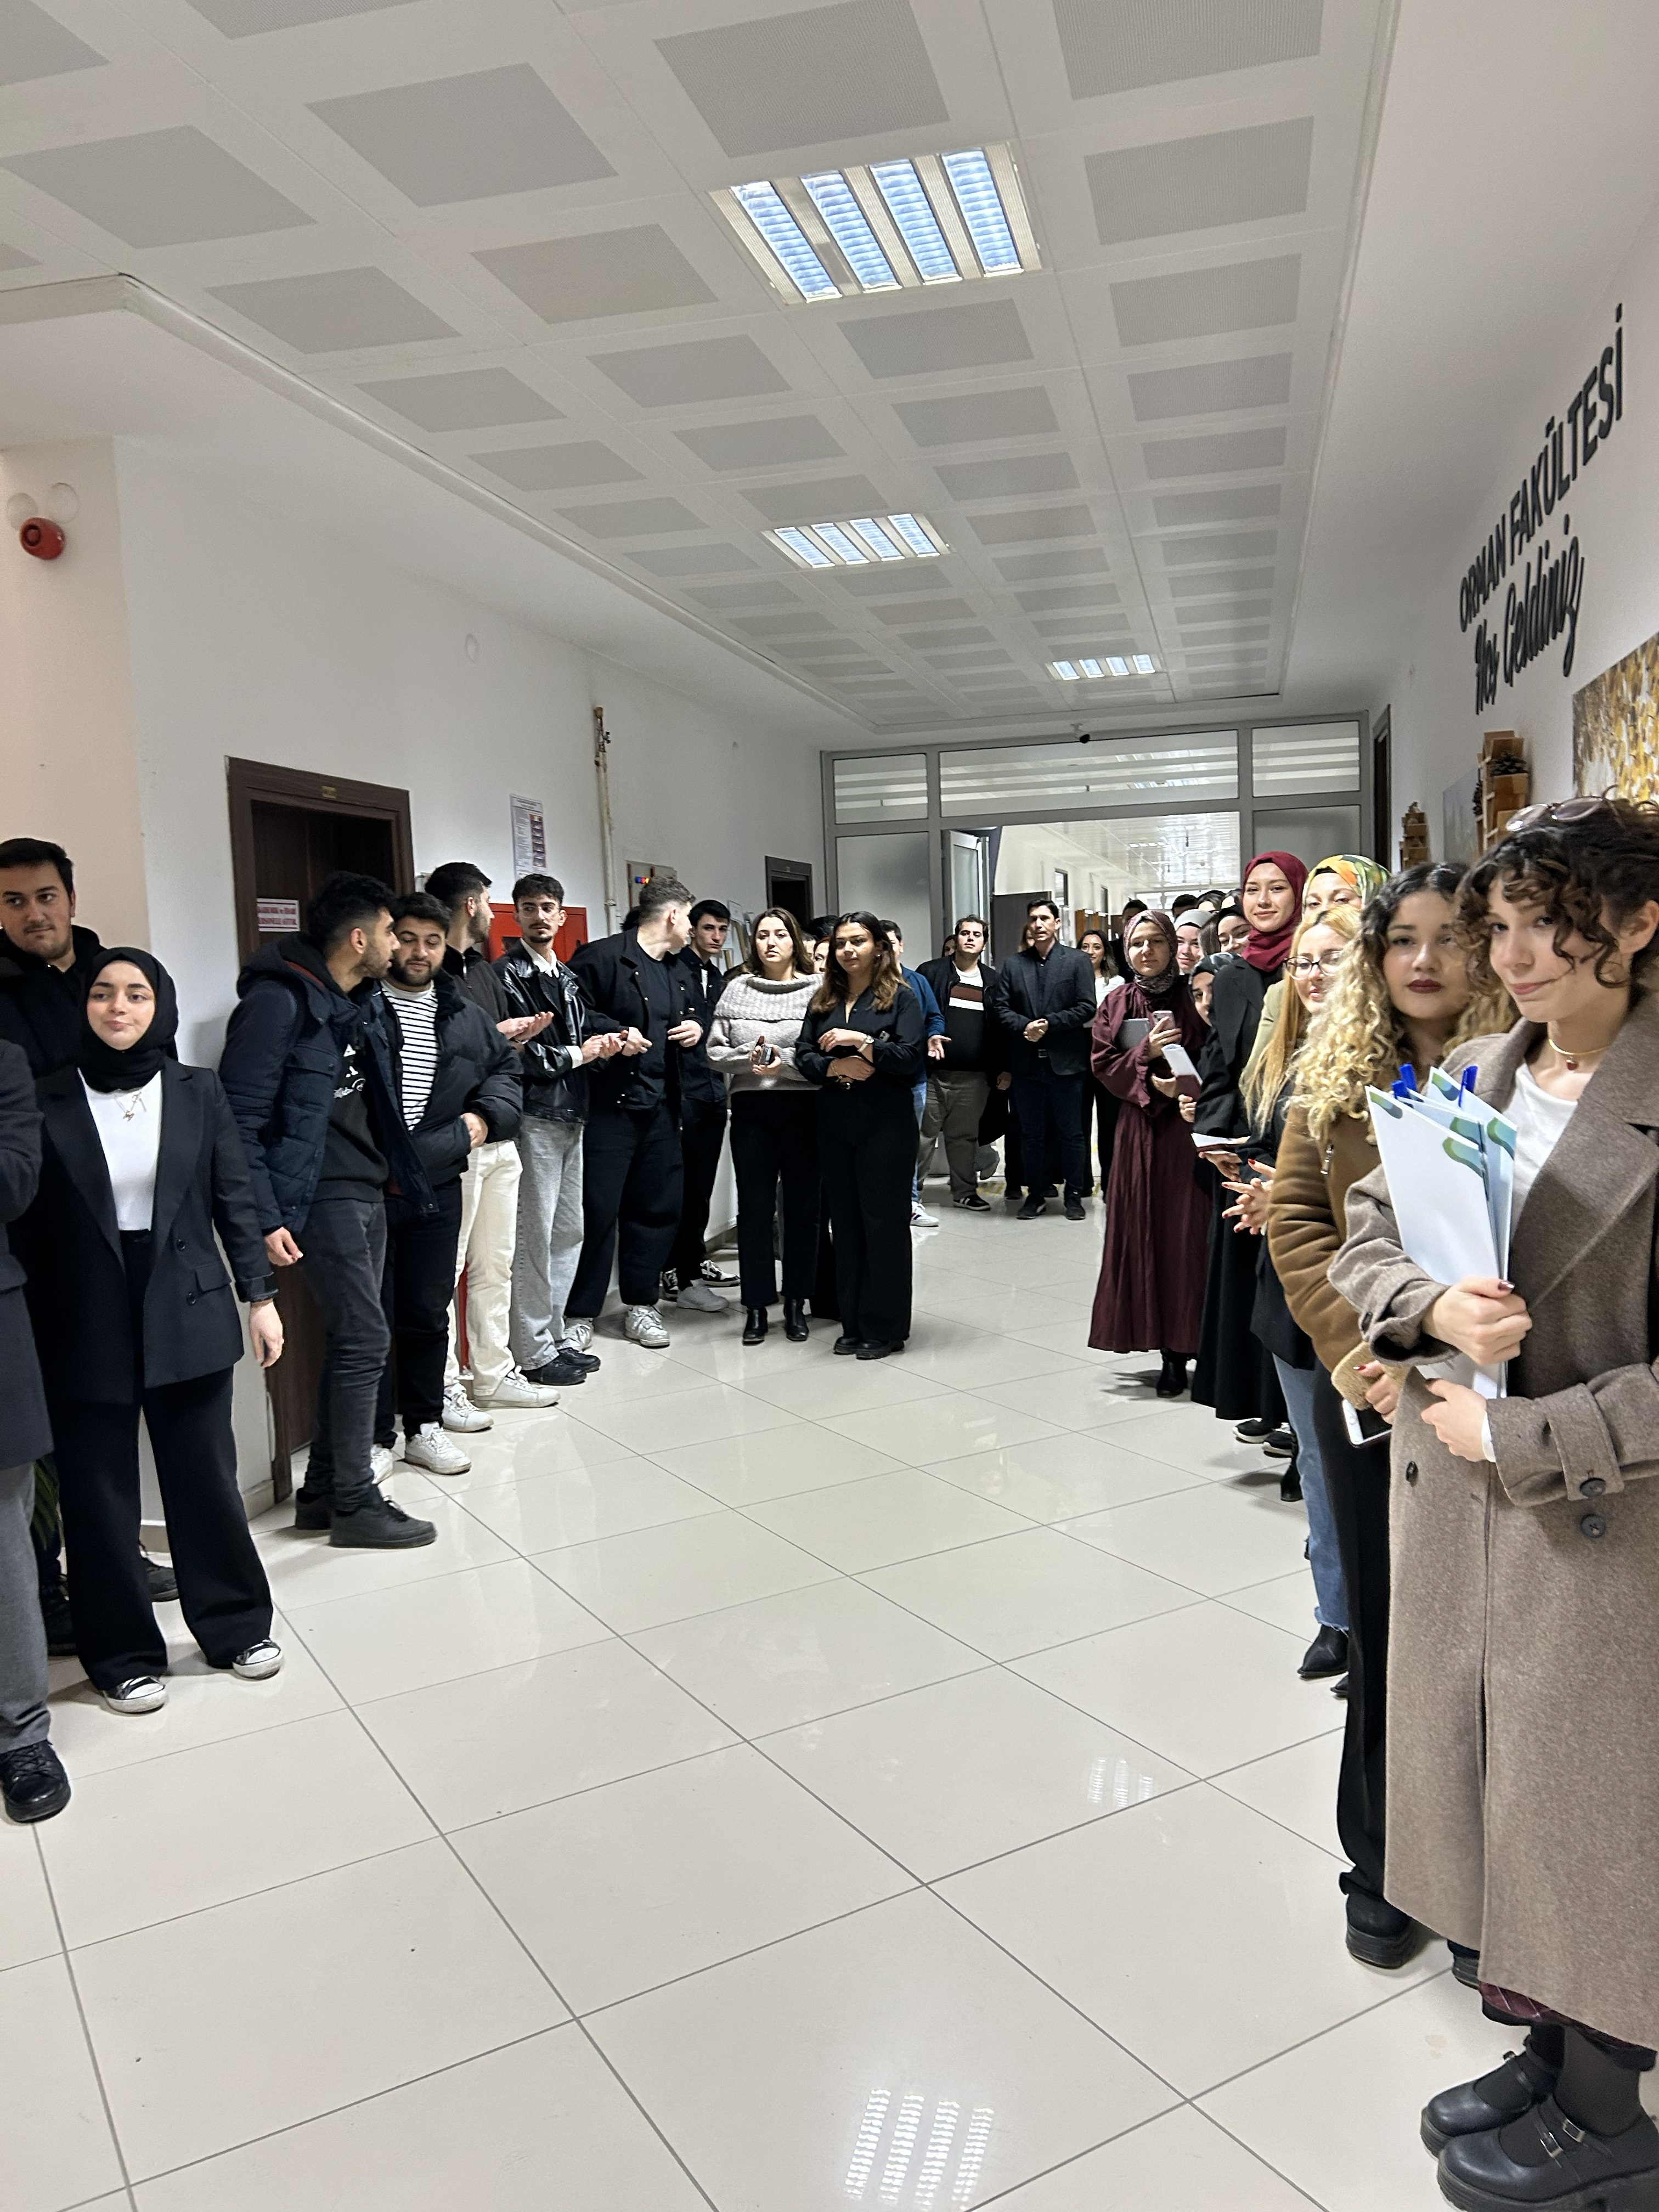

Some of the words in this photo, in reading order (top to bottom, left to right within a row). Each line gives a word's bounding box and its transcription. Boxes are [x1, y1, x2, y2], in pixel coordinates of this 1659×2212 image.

[1459, 513, 1506, 633] ORMAN
[1509, 302, 1623, 566] FAKÜLTESİ
[1503, 514, 1585, 688] Geldiniz
